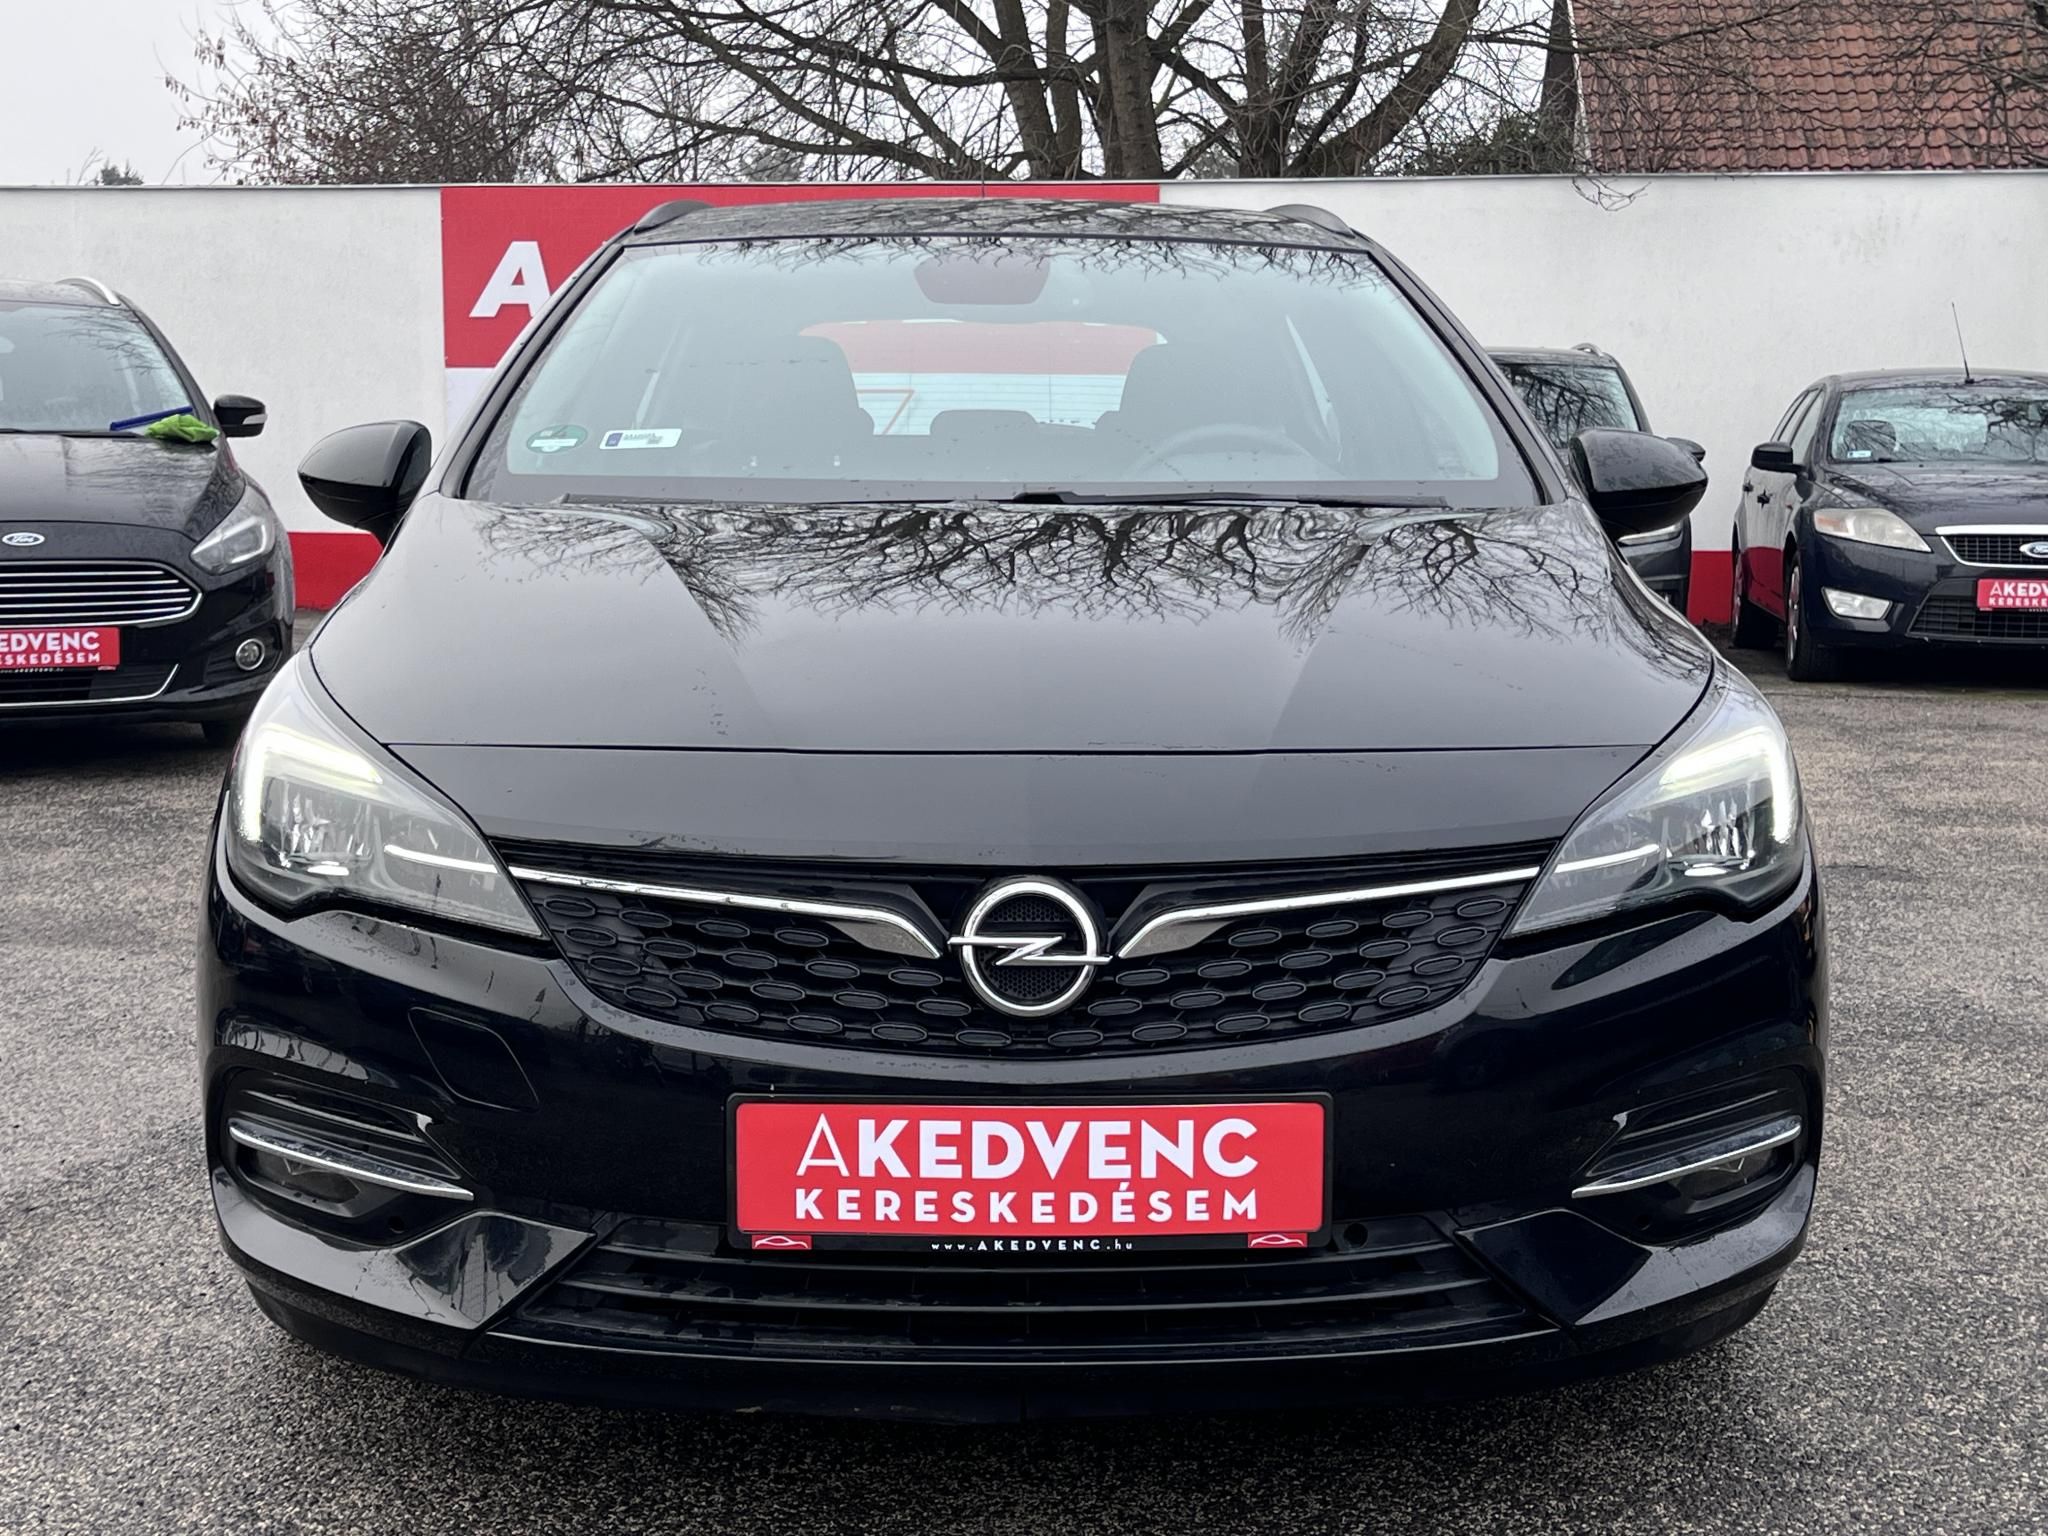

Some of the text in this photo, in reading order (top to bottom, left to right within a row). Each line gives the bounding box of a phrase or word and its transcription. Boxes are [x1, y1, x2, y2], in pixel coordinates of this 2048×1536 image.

[469, 240, 551, 318] A
[796, 1114, 1258, 1179] AKEDVENC
[796, 1181, 1257, 1223] KERESKEDÉSEM
[931, 1239, 1133, 1251] www.AKEDVENC.hu
